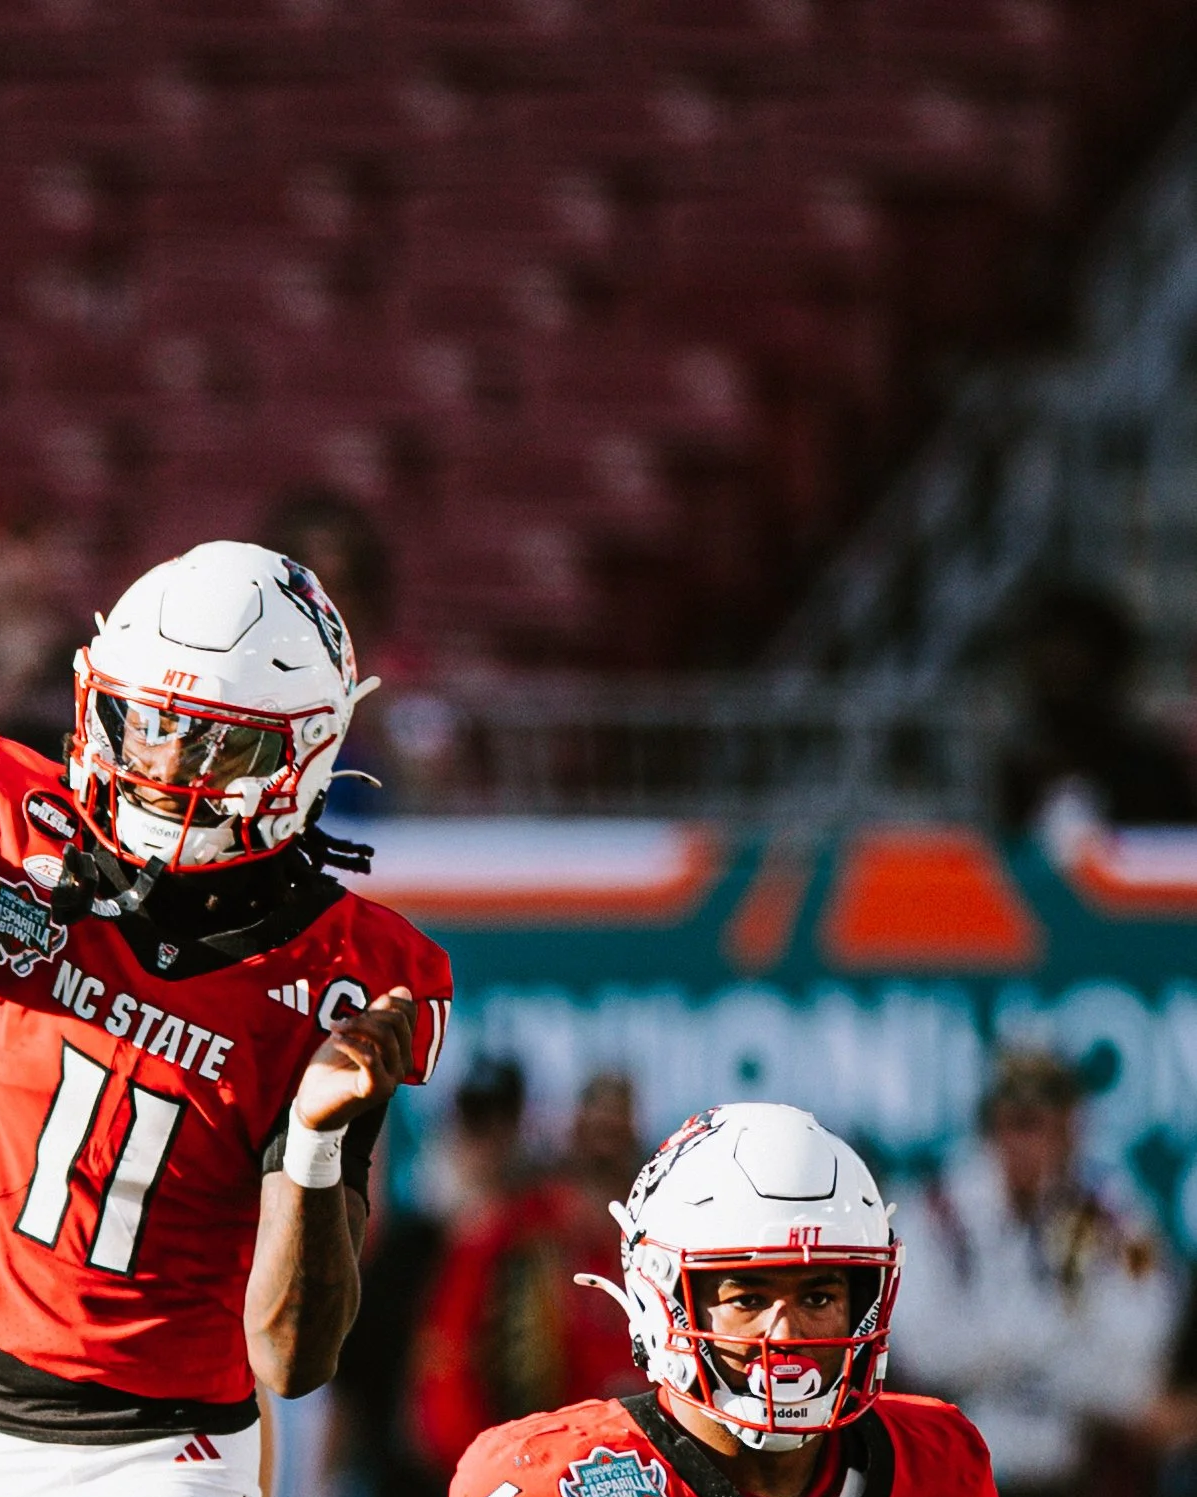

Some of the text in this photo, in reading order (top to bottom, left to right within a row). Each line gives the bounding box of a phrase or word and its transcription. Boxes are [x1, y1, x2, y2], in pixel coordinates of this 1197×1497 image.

[162, 669, 199, 690] HTT
[51, 960, 234, 1081] NC STATE
[15, 1039, 187, 1278] 11
[788, 1226, 822, 1247] HTT
